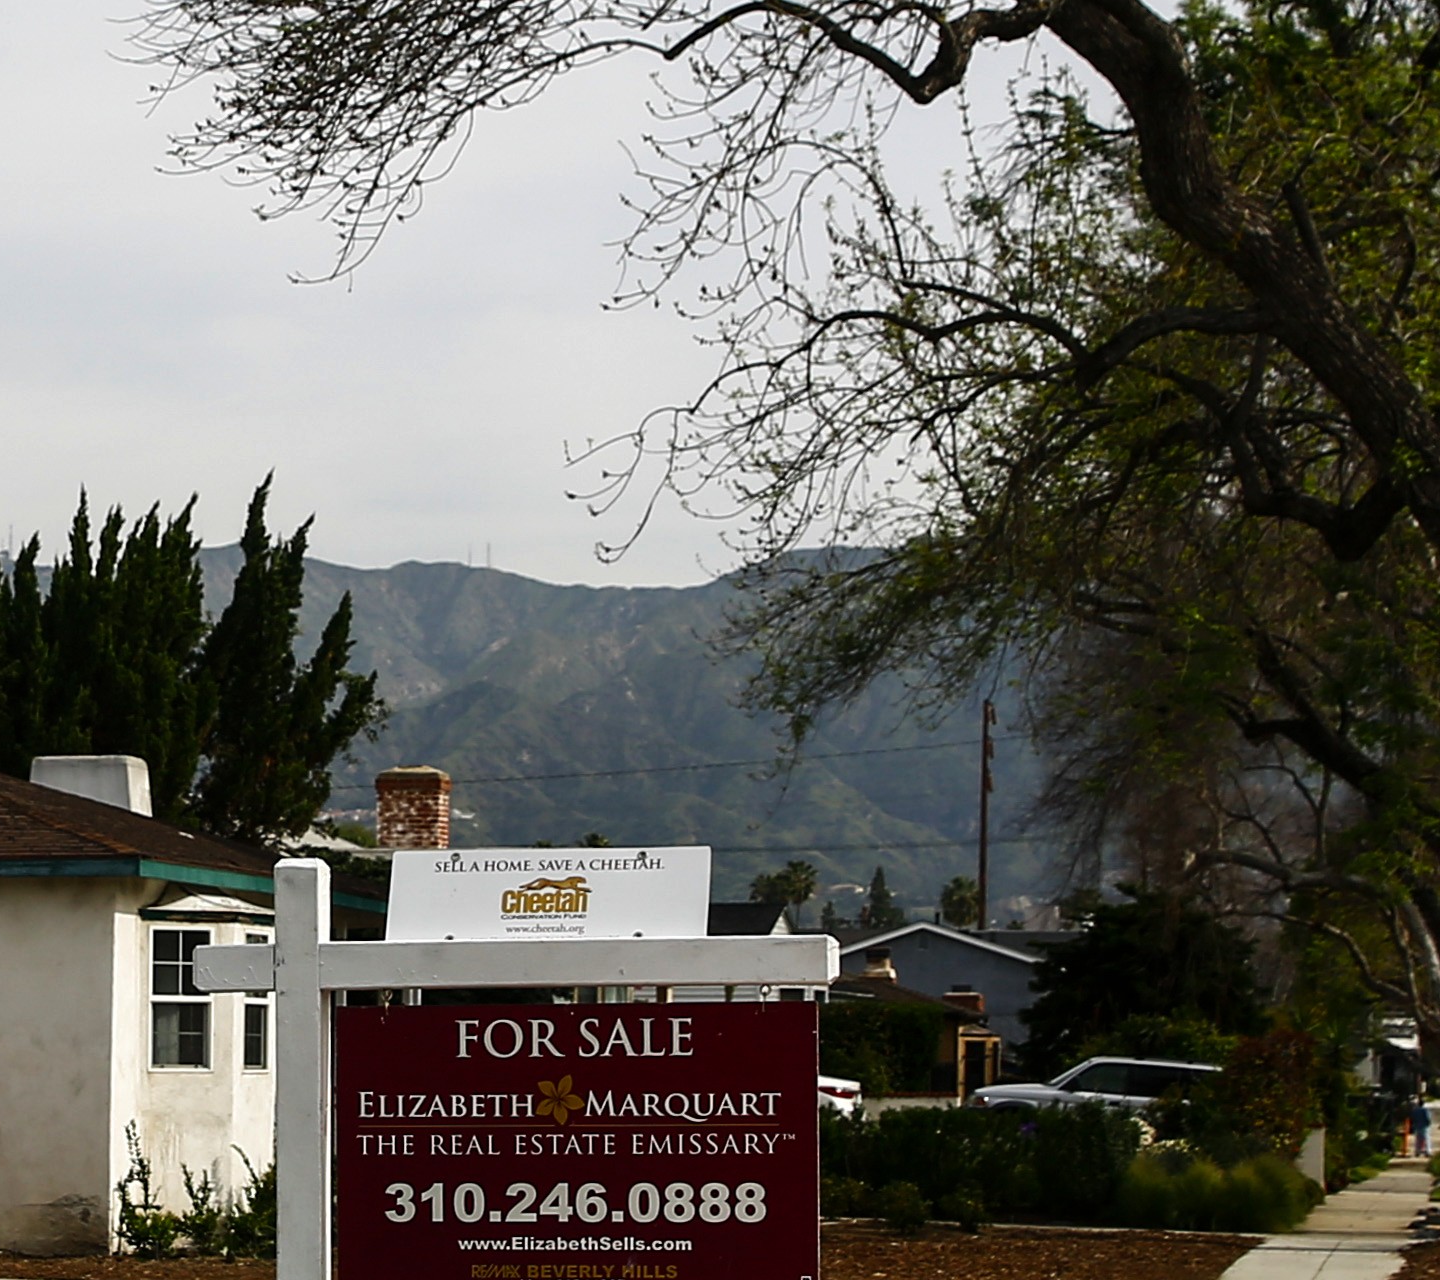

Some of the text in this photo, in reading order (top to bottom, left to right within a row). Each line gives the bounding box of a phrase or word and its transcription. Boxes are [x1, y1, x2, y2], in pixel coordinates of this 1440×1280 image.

[434, 859, 466, 873] SELL
[468, 860, 481, 872] A
[537, 858, 573, 872] SAVE
[574, 858, 585, 871] A
[500, 888, 587, 913] Cheetah
[505, 923, 585, 935] www.cheetah.org
[455, 1017, 694, 1058] FOR SALE
[357, 1090, 782, 1122] ELIZABETH MARQUART
[356, 1134, 414, 1156] THE
[430, 1134, 501, 1156] REAL
[514, 1133, 616, 1156] ESTATE
[384, 1182, 767, 1223] 310.246.0888
[457, 1236, 693, 1252] www.ElizabethSells.com
[527, 1265, 614, 1279] BEVERLY
[621, 1265, 678, 1279] HILLS
